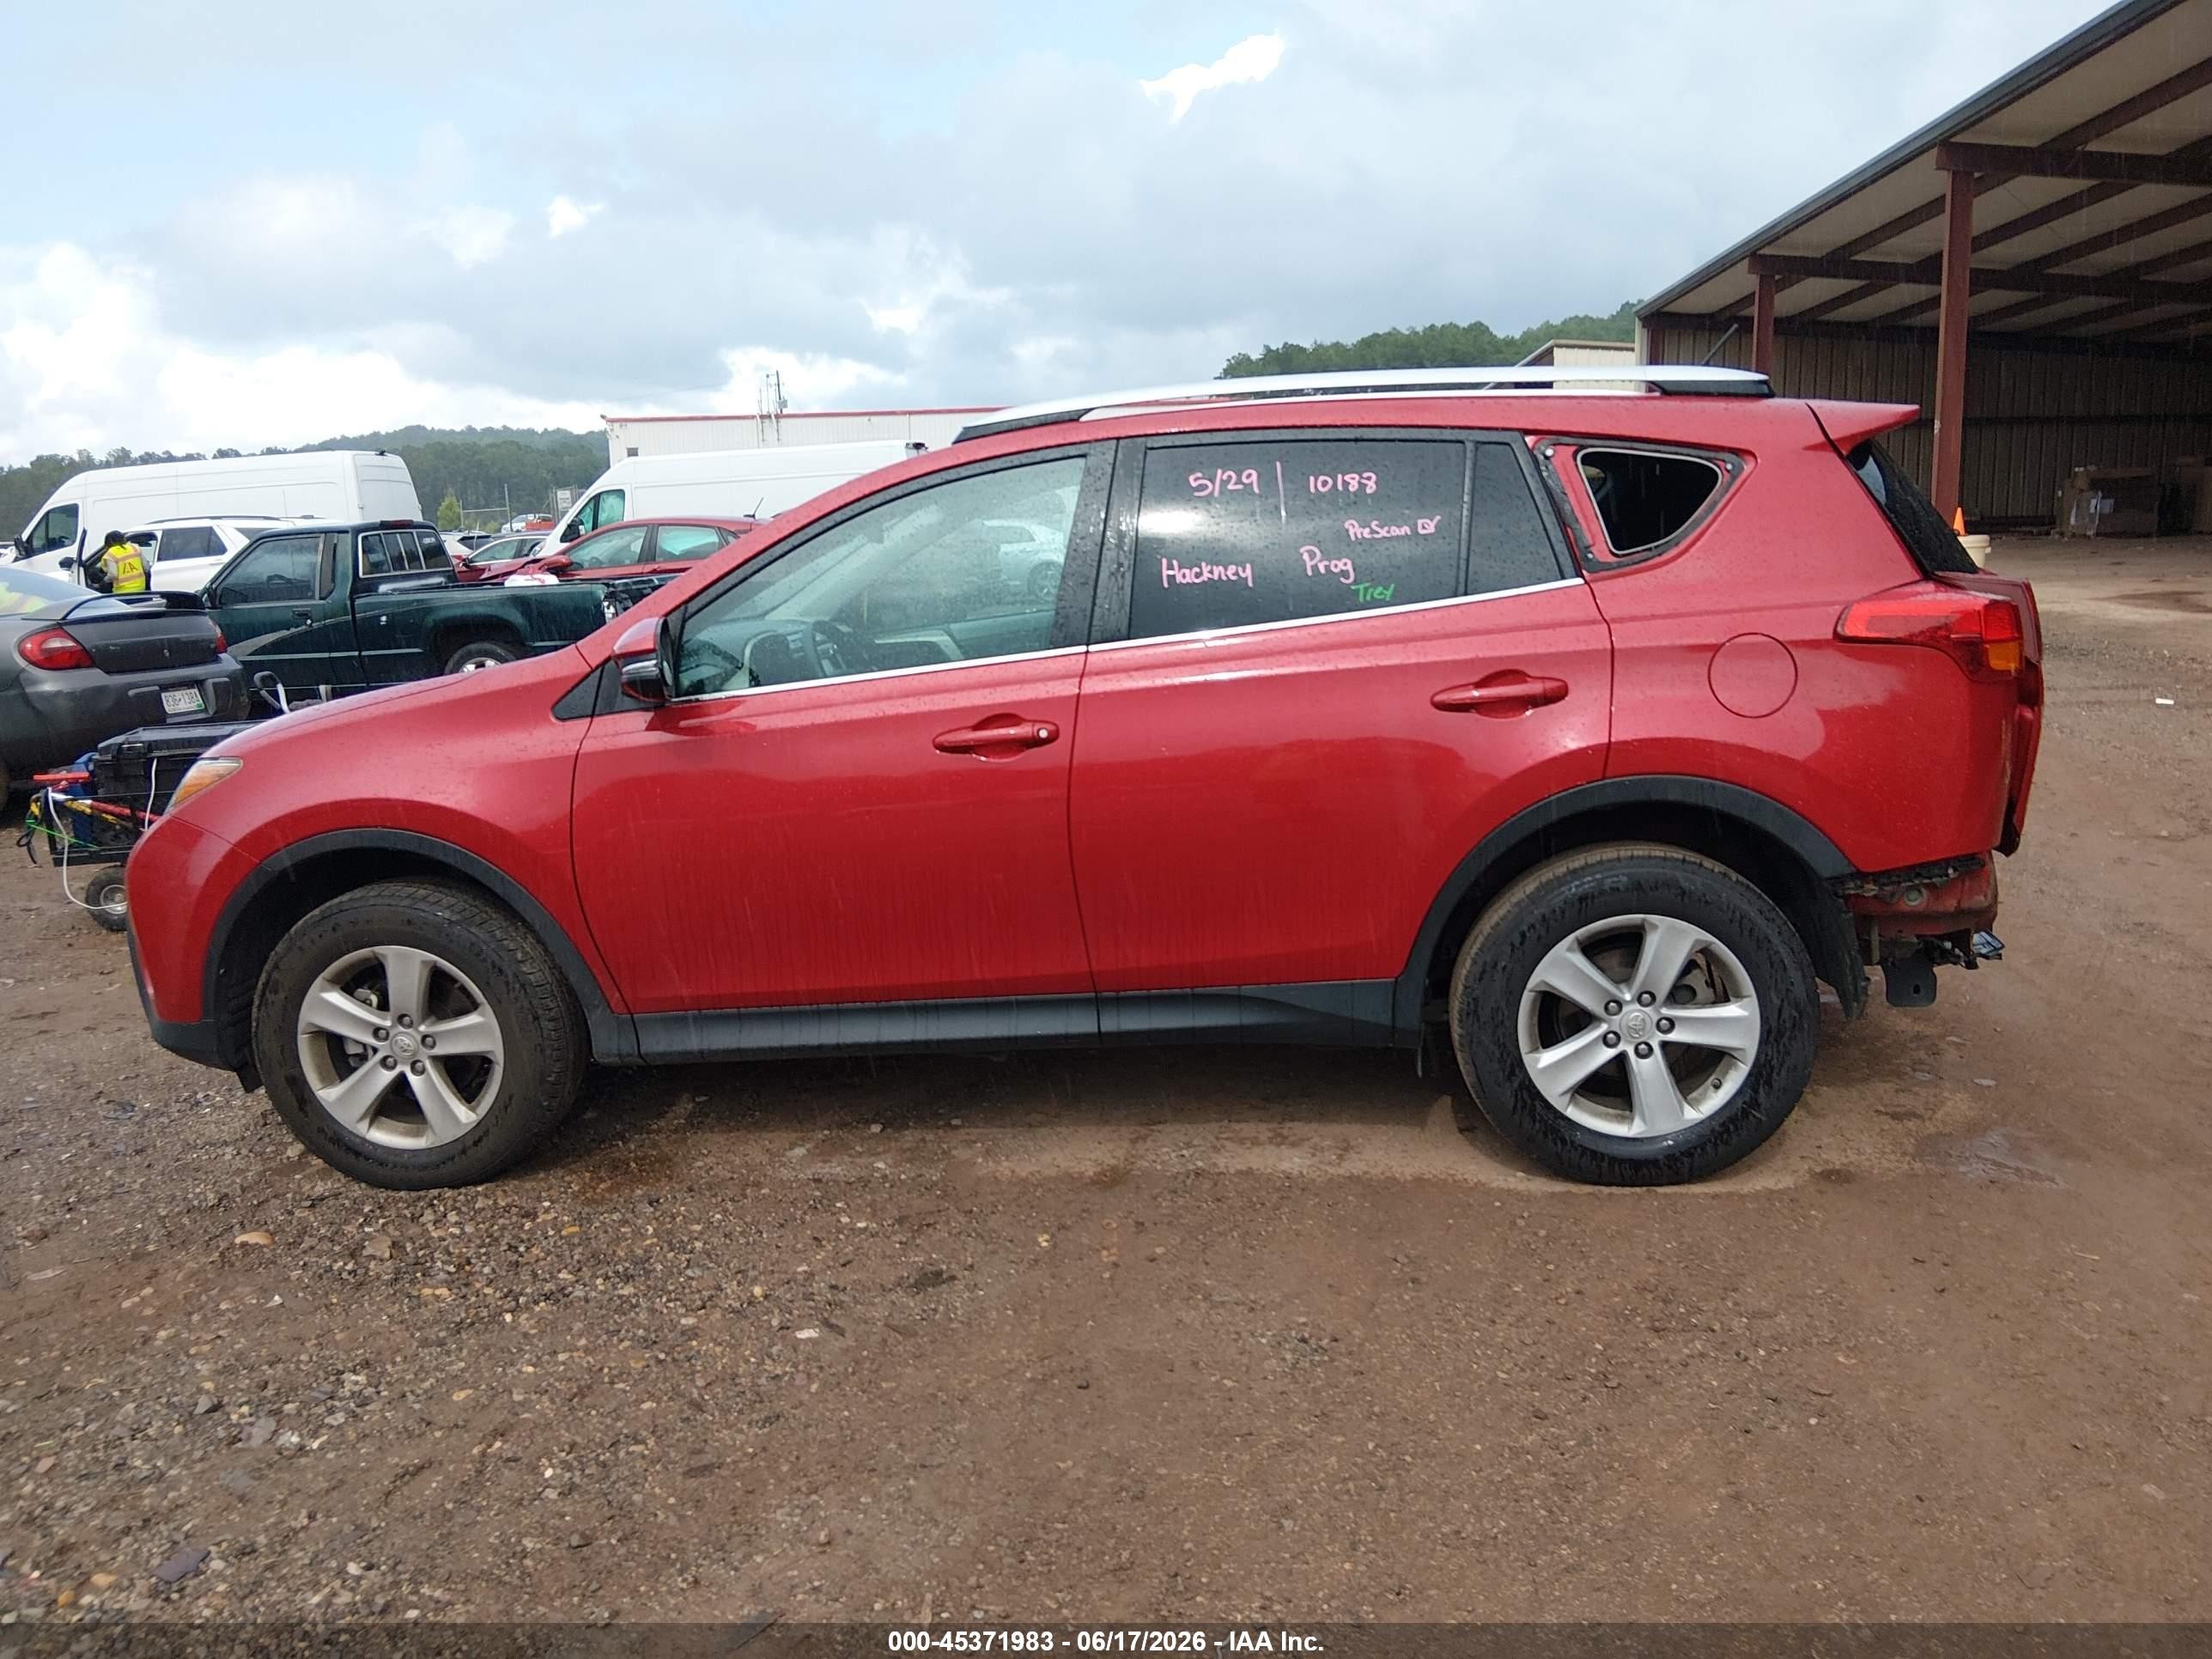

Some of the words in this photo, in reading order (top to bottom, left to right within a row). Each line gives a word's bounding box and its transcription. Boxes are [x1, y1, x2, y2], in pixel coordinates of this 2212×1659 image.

[1189, 469, 1261, 496] 5/29
[1162, 558, 1254, 587] Hackney
[1299, 545, 1355, 583] Prog
[1351, 582, 1395, 603] Trey
